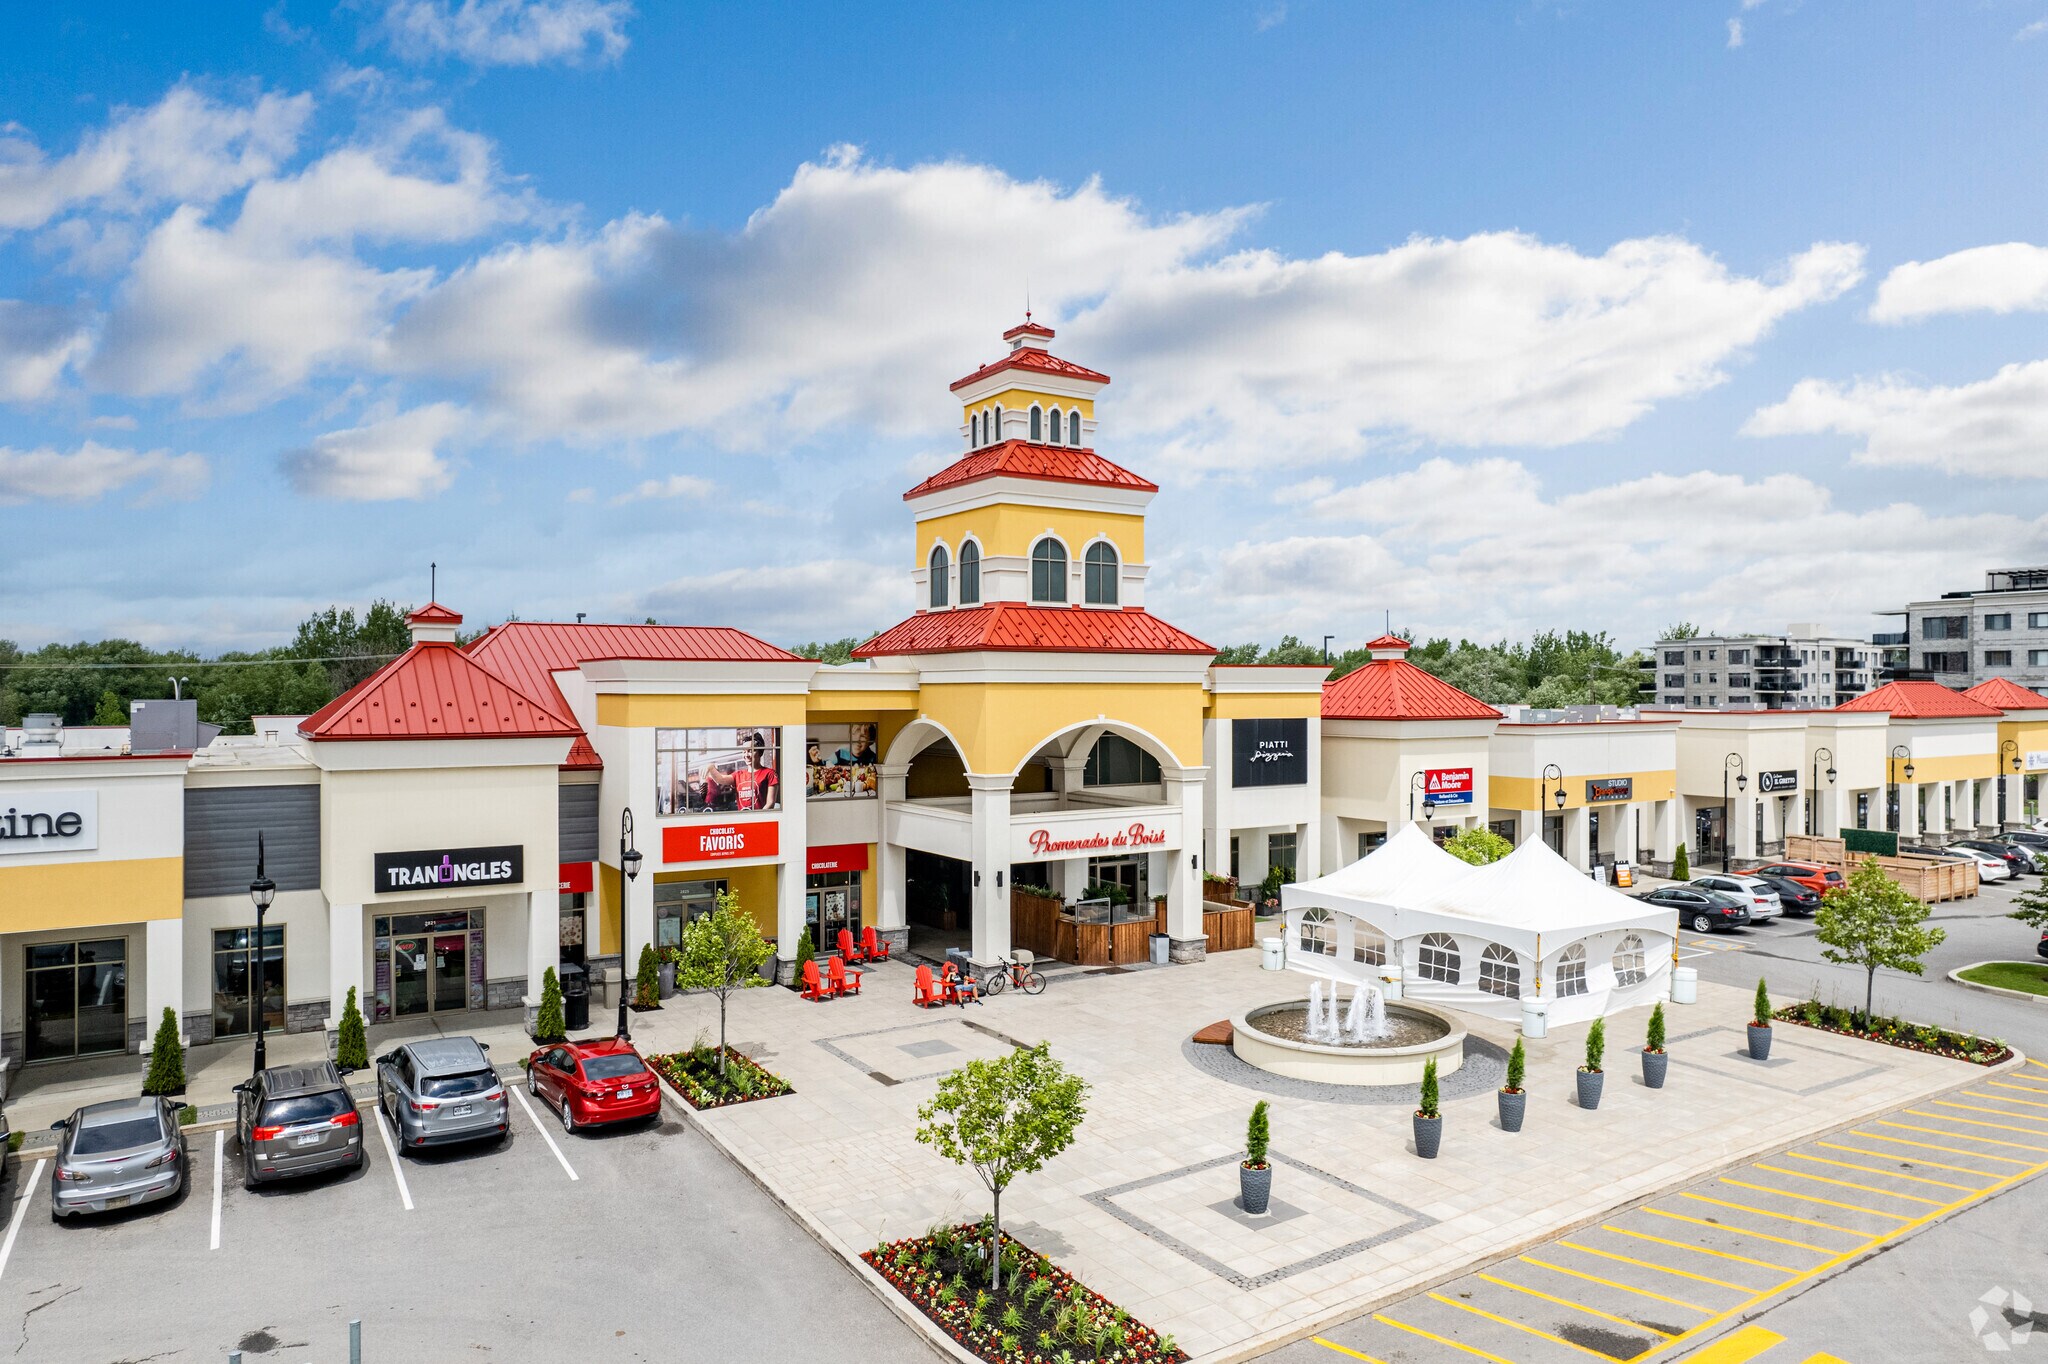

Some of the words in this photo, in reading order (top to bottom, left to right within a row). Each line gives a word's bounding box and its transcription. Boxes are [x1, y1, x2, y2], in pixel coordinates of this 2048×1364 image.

[1259, 740, 1288, 749] PIATTI
[1441, 771, 1470, 782] Benjamin
[1441, 781, 1461, 789] Moore
[1607, 779, 1628, 787] STUDIO
[709, 827, 735, 835] CHOCOLATS
[700, 833, 745, 852] FAVORIS
[1028, 829, 1110, 855] Promenades
[1111, 830, 1128, 847] du
[1127, 822, 1166, 847] Boisé
[811, 861, 838, 870] CHOCOLATERIE
